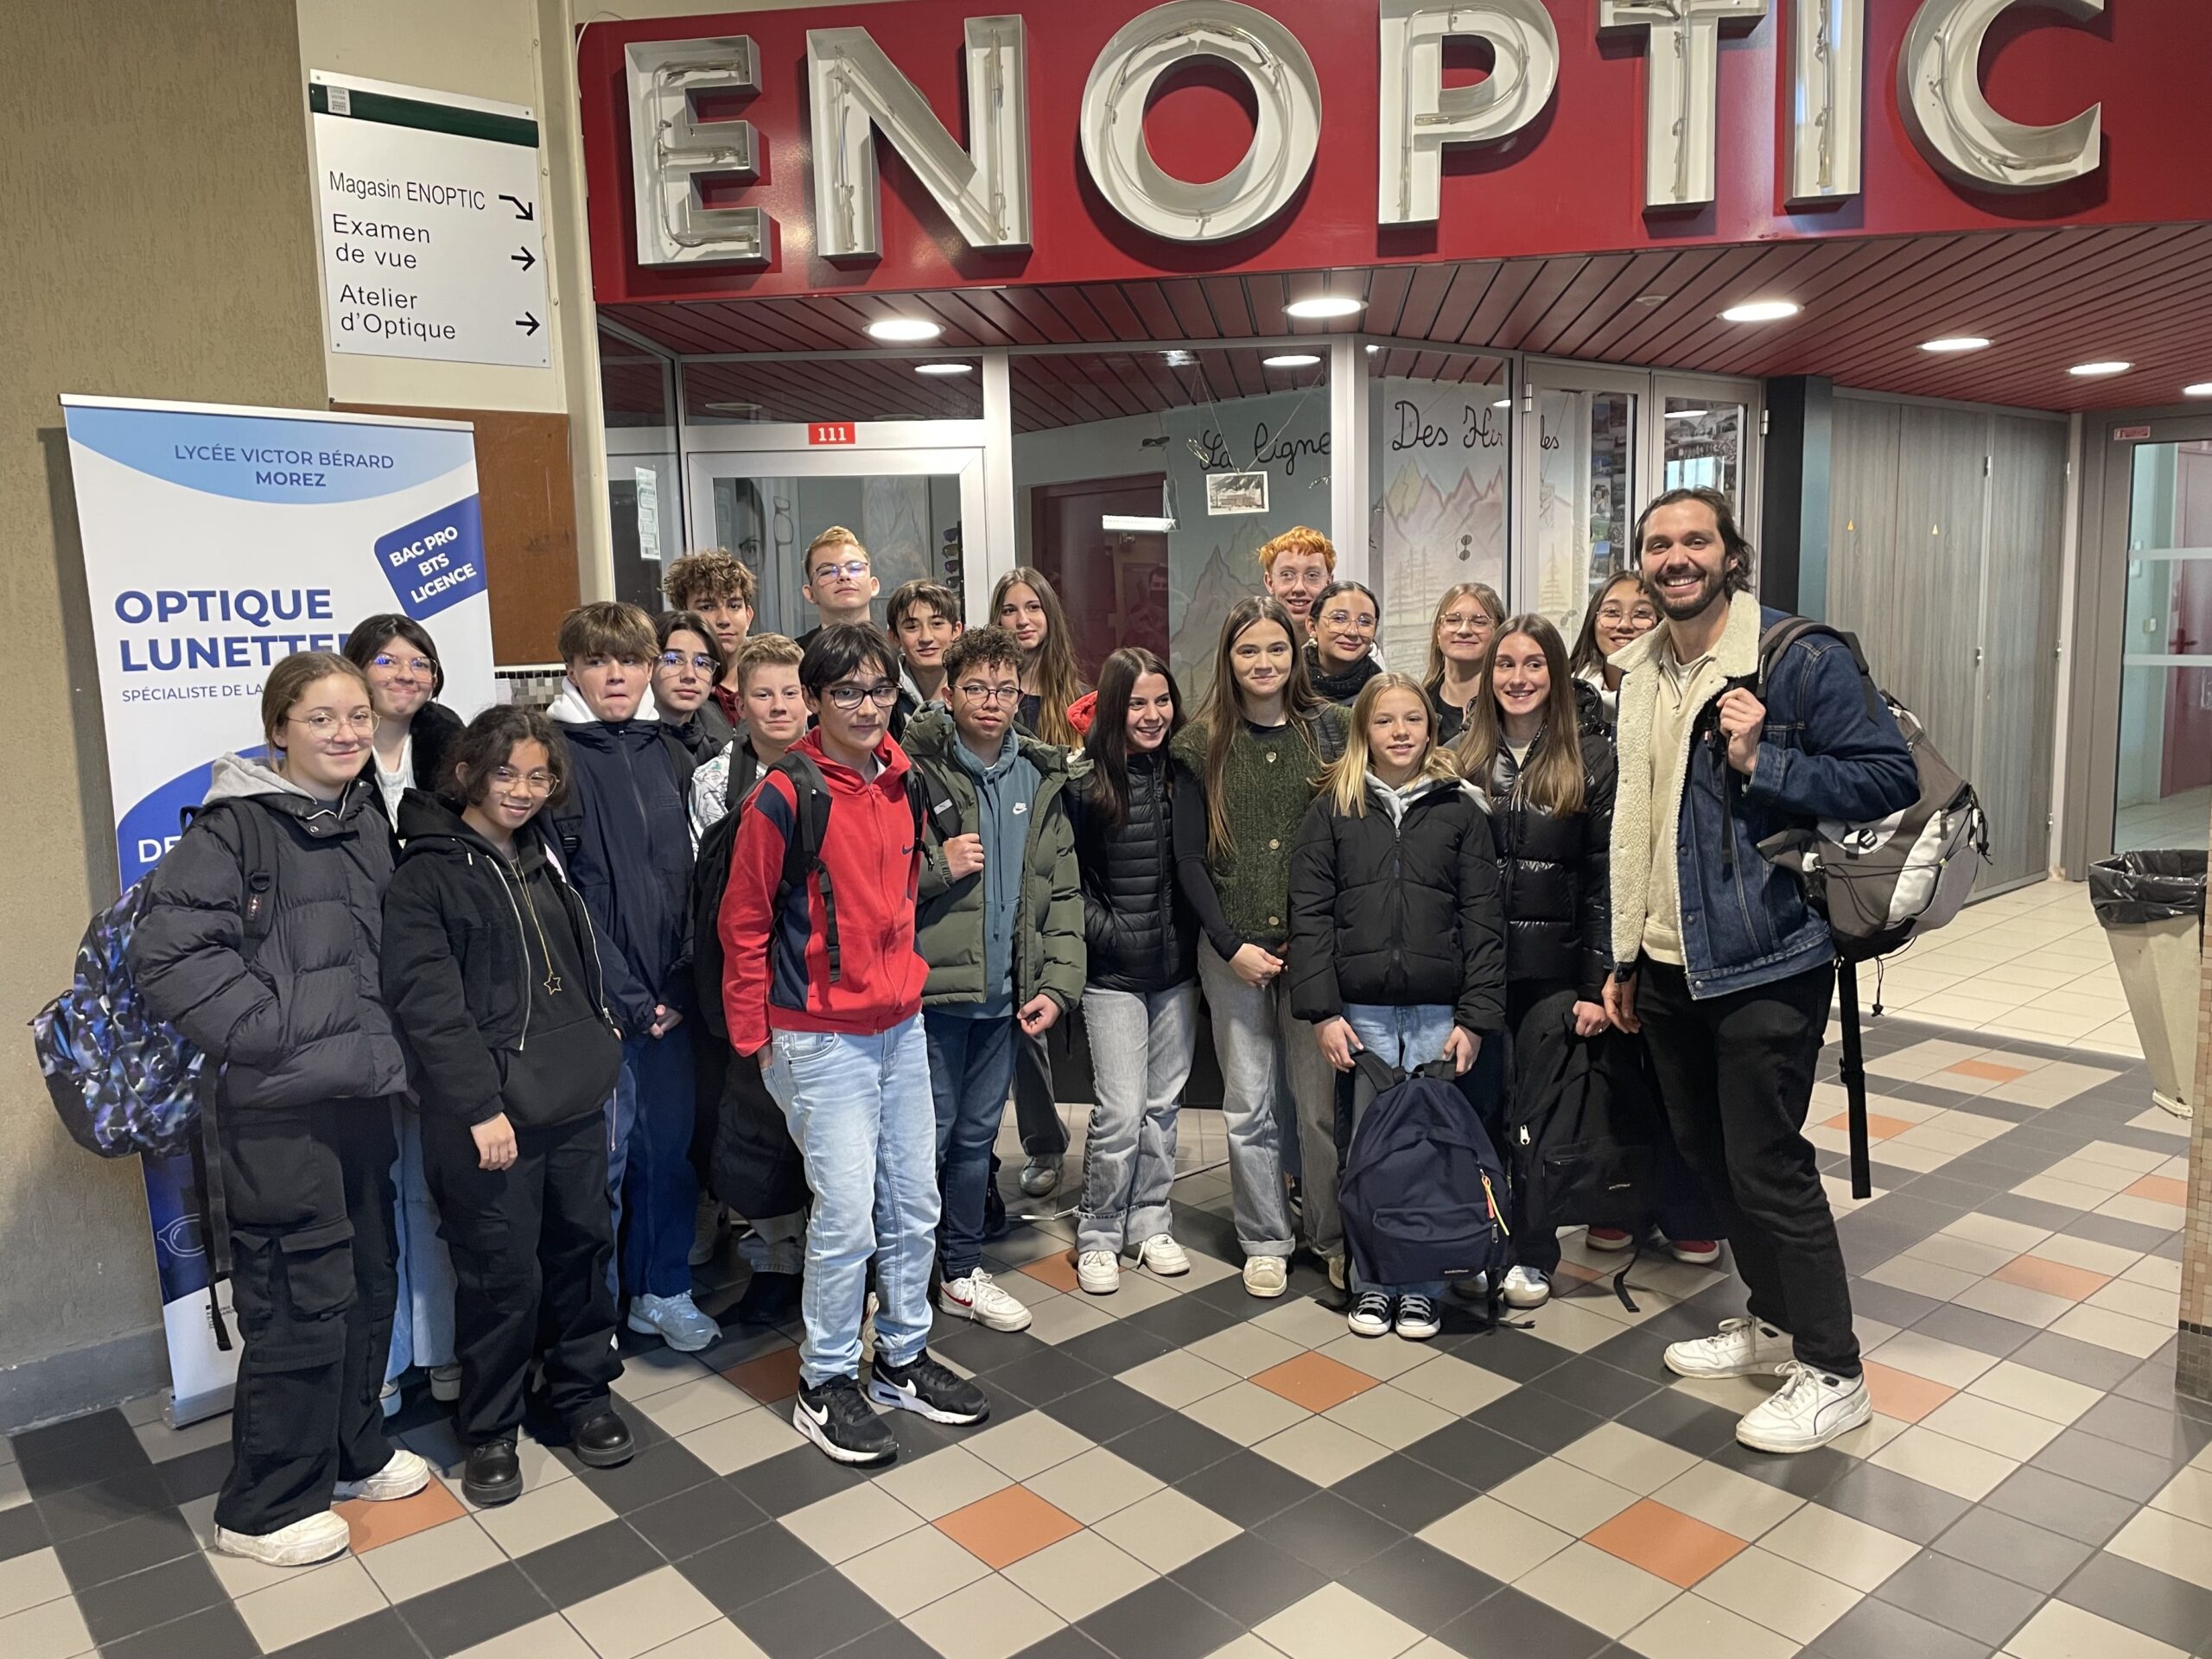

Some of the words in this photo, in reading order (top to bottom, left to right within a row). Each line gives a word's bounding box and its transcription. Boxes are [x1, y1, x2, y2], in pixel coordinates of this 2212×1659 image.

[624, 0, 2106, 267] ENOPTIC
[329, 170, 401, 200] Magasin
[407, 181, 486, 211] ENOPTIC
[333, 213, 430, 245] Examen
[335, 242, 365, 264] de
[375, 249, 417, 270] vue
[340, 283, 418, 310] Atelier
[340, 311, 456, 342] d'Optique
[818, 427, 847, 442] 111
[1392, 400, 1449, 451] Des
[175, 443, 236, 461] LYCÉE
[240, 448, 313, 466] VICTOR
[319, 450, 395, 469] BÉRARD
[256, 471, 327, 487] MOREZ
[389, 541, 425, 567] BAC
[423, 526, 458, 550] PRO
[418, 553, 449, 577] BTS
[410, 563, 477, 604] LICENCE
[115, 588, 334, 627] OPTIQUE
[122, 685, 218, 702] SPÉCIALISTE
[222, 684, 243, 697] DE
[246, 683, 265, 696] LA
